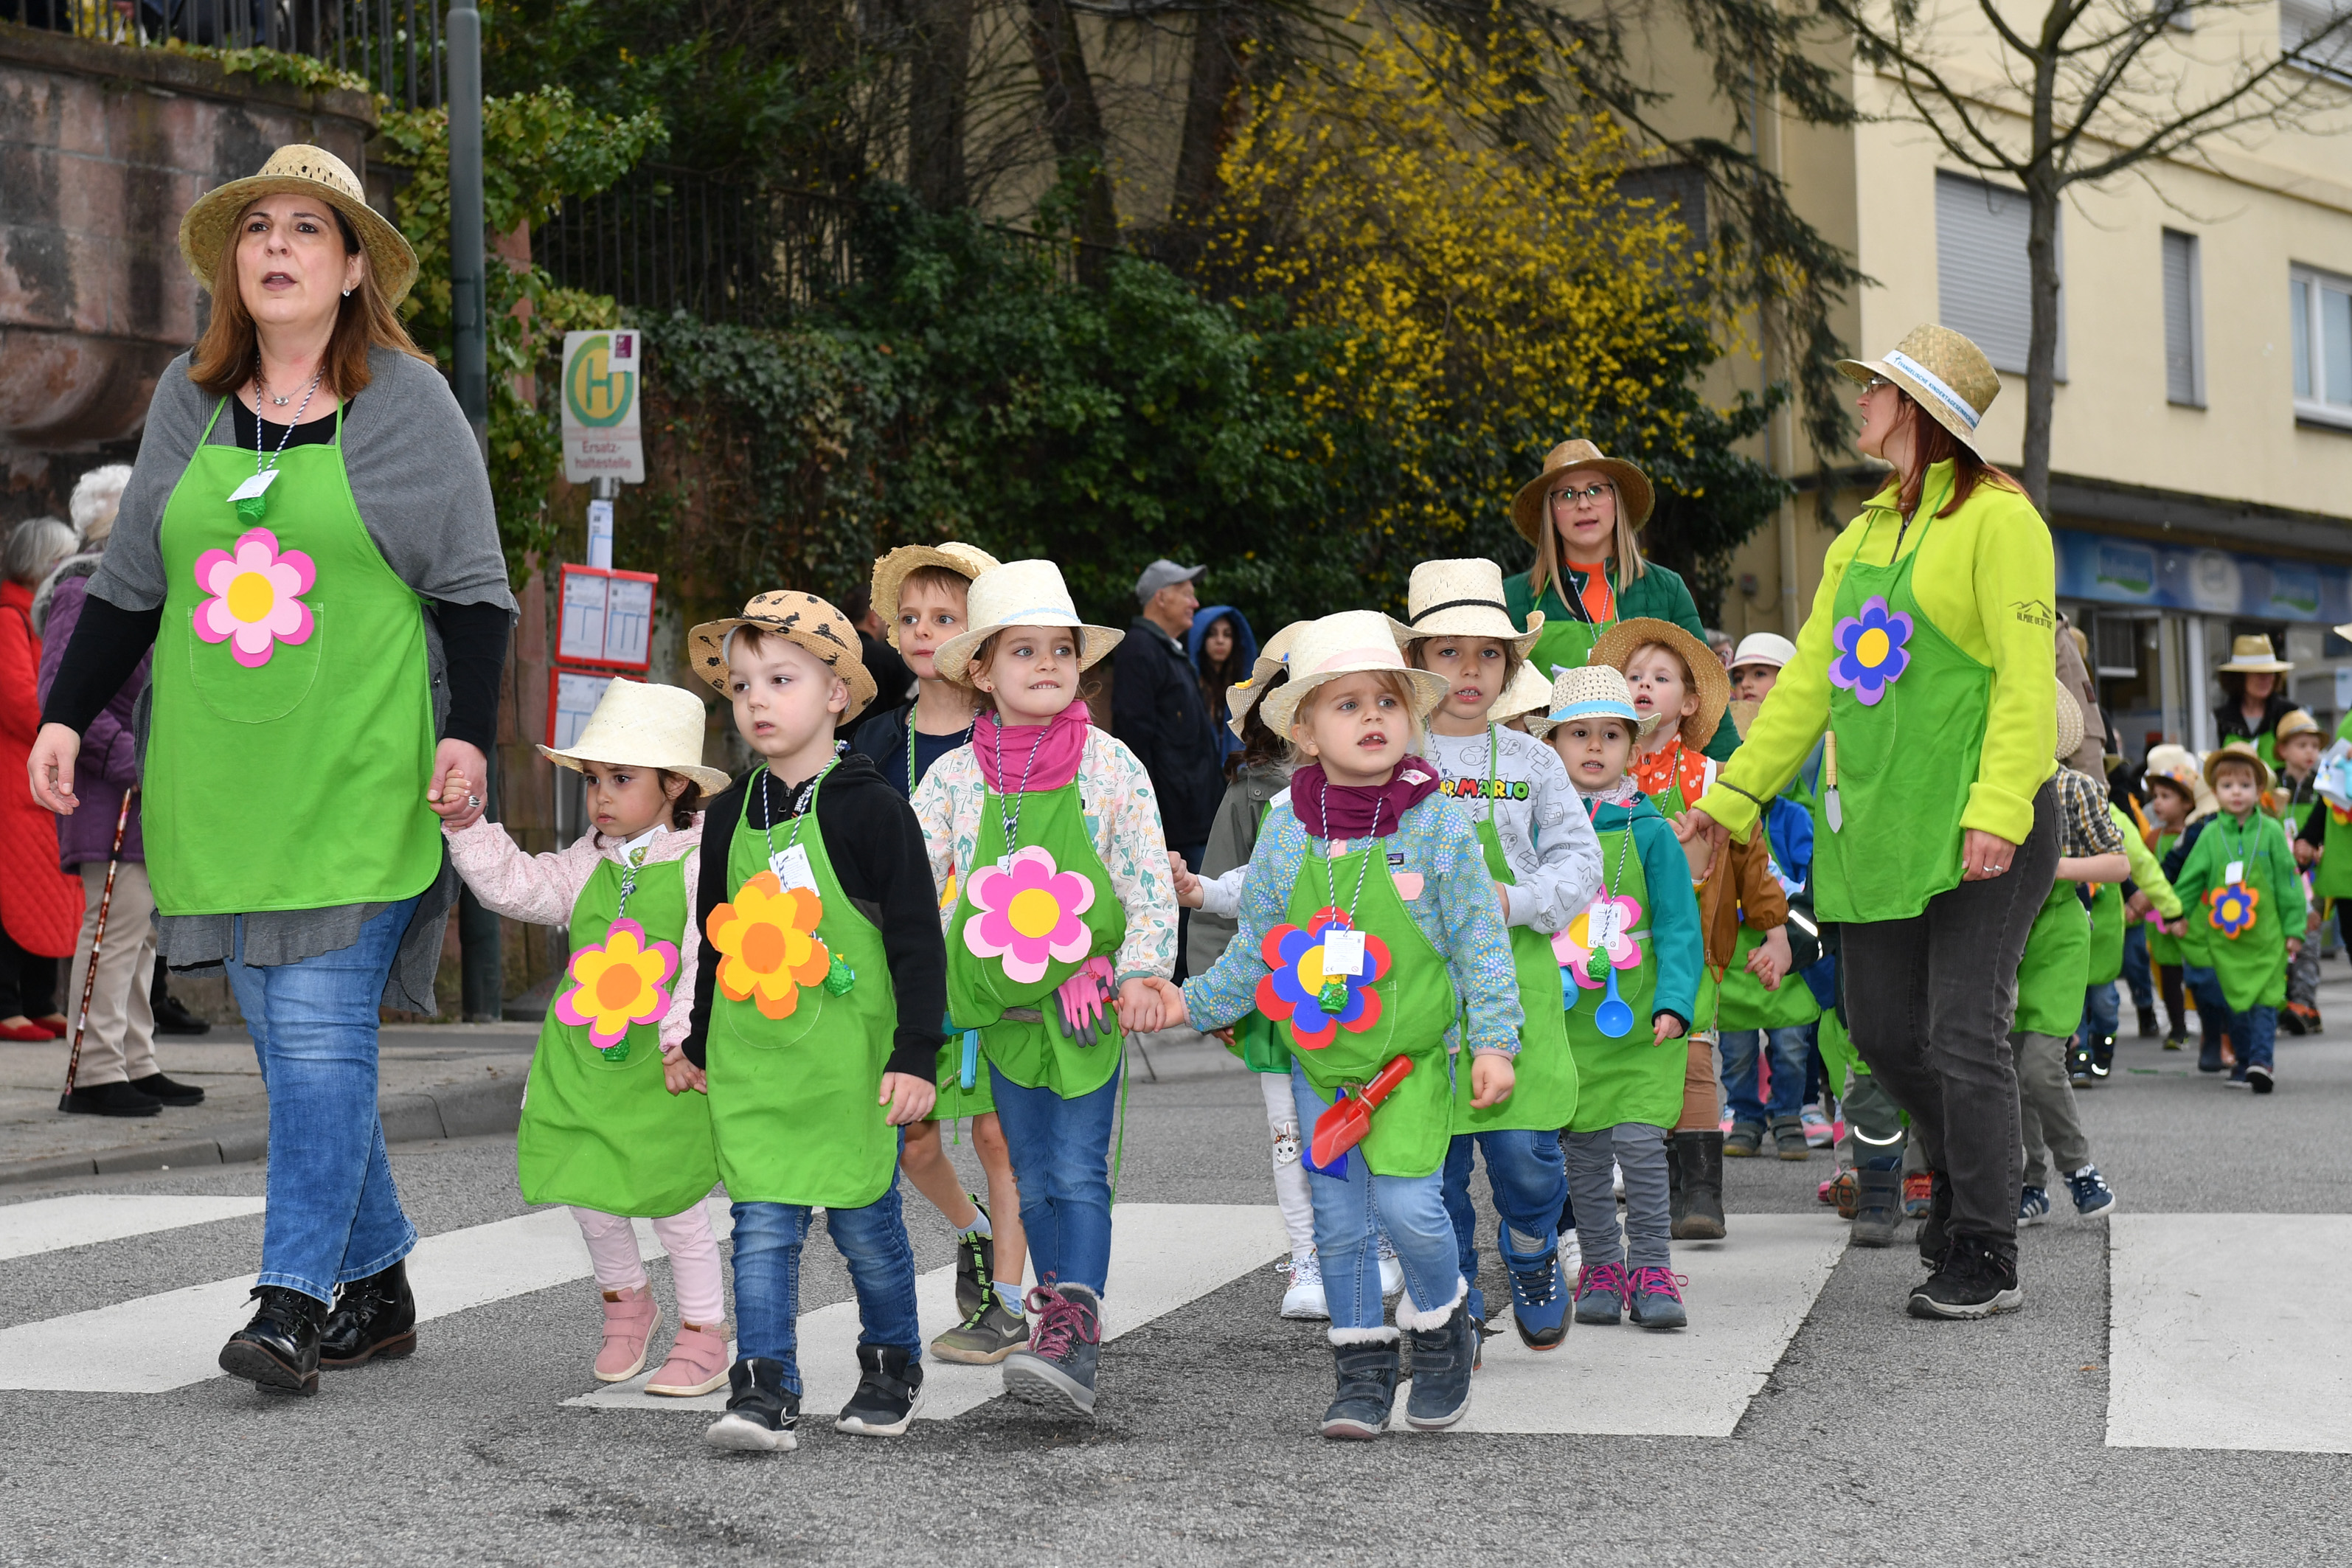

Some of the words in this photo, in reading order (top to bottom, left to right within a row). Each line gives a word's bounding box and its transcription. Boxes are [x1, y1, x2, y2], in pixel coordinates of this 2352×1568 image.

[1897, 361, 1929, 384] EVANGELISCHE
[586, 357, 614, 410] H
[582, 441, 622, 454] Ersatz-
[575, 457, 632, 469] haltestelle
[1456, 778, 1530, 802] MARIO
[974, 1253, 984, 1269] NIKE
